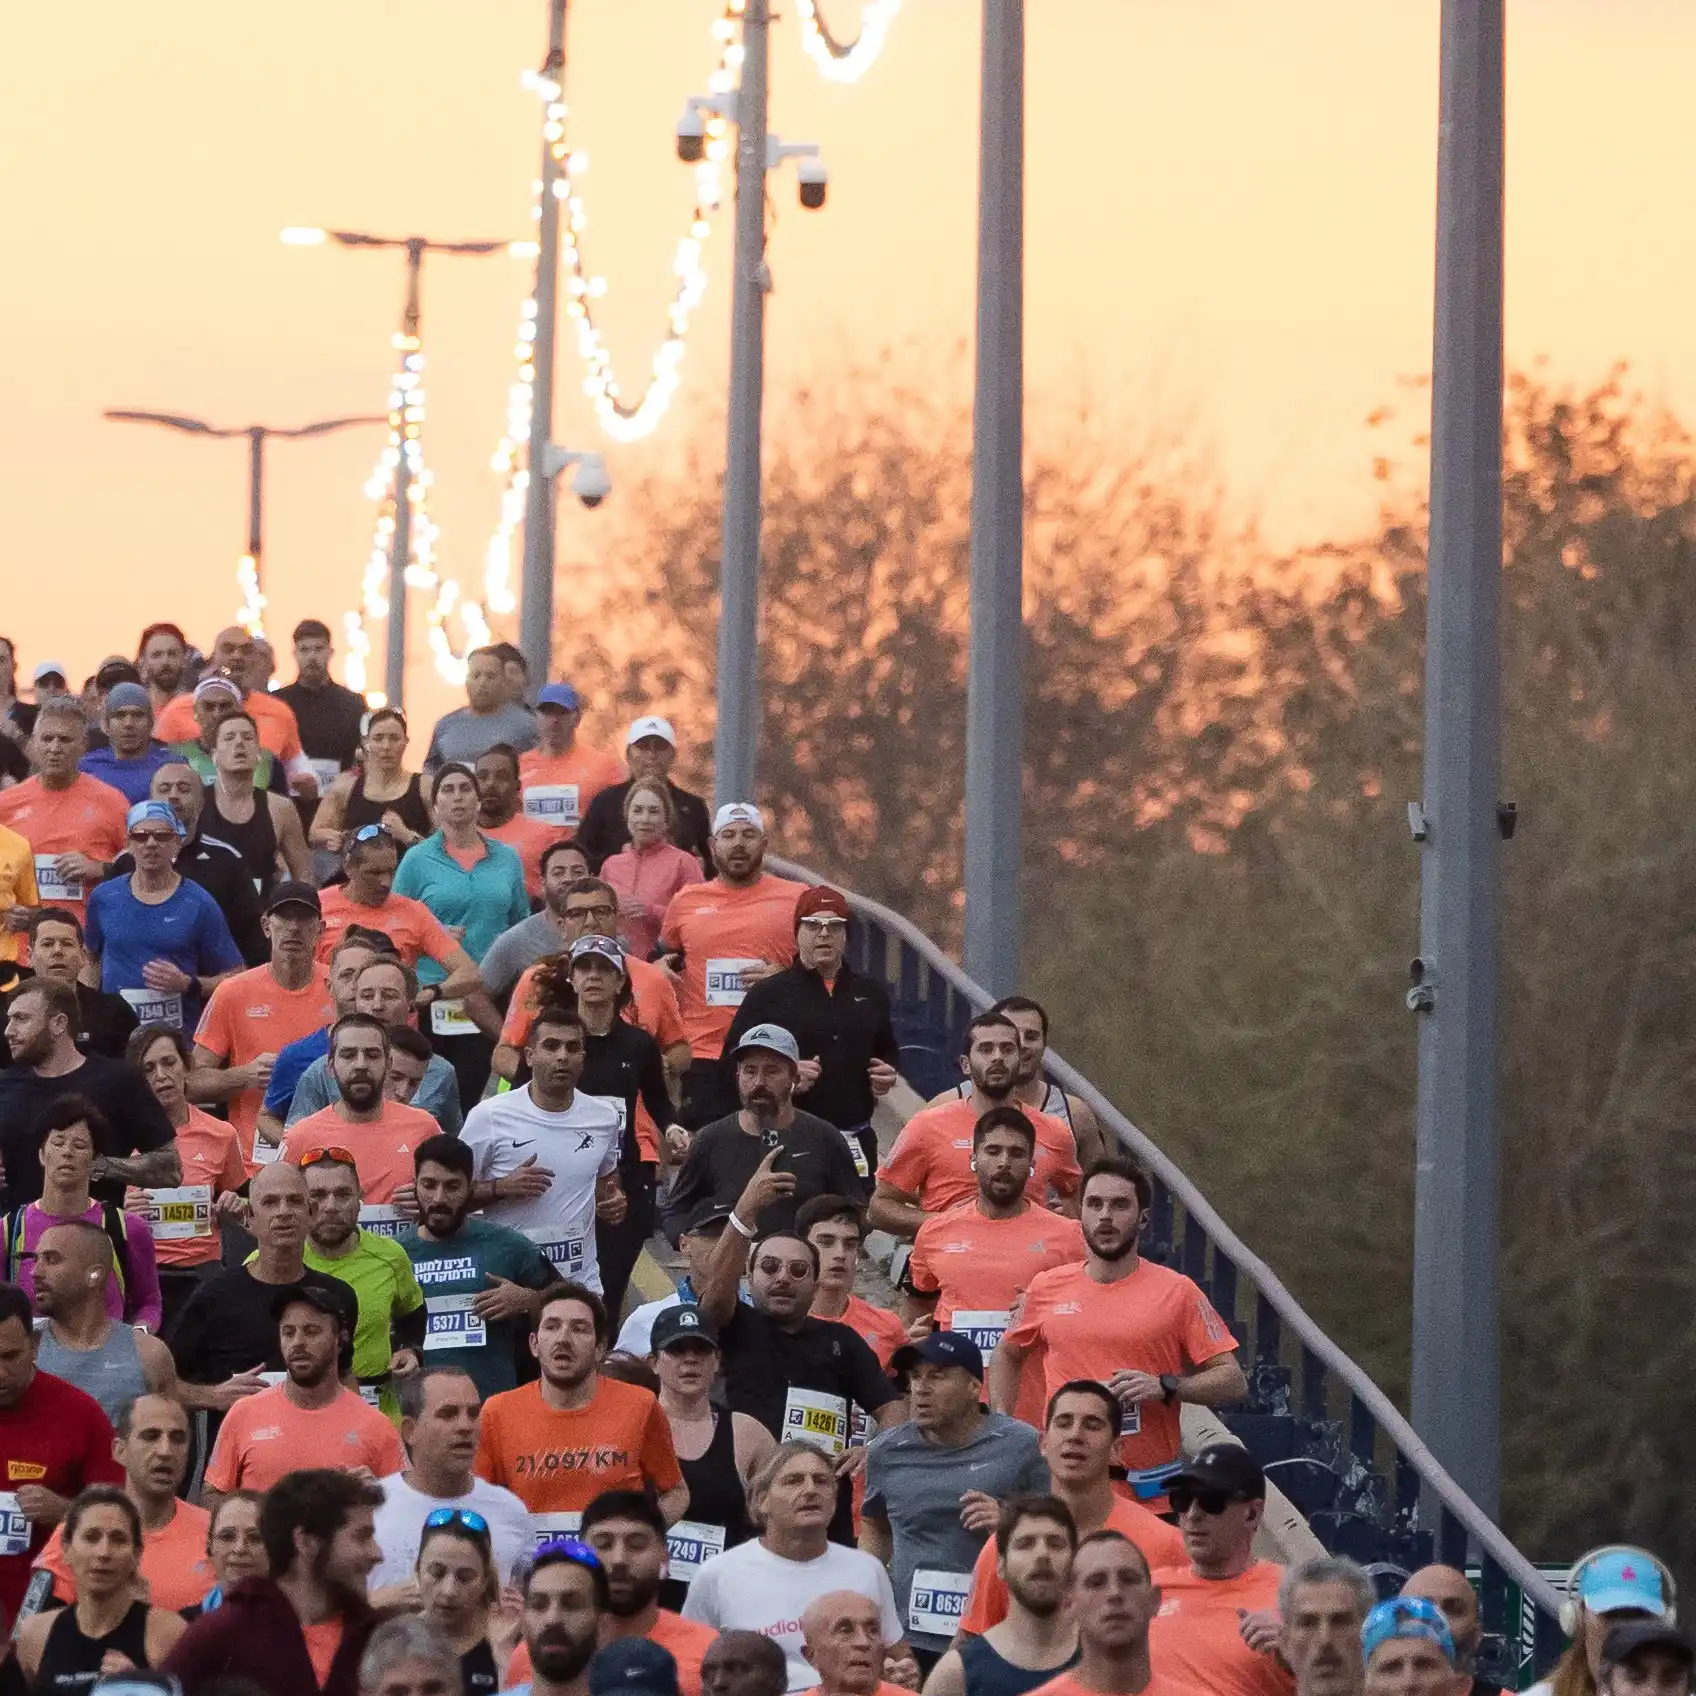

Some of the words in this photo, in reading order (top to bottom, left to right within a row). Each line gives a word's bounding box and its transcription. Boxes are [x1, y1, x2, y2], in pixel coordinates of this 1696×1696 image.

[546, 1244, 565, 1261] 017
[444, 1256, 472, 1270] רצים
[433, 1314, 460, 1331] 5377
[807, 1411, 836, 1433] 14261
[596, 1450, 628, 1467] KM
